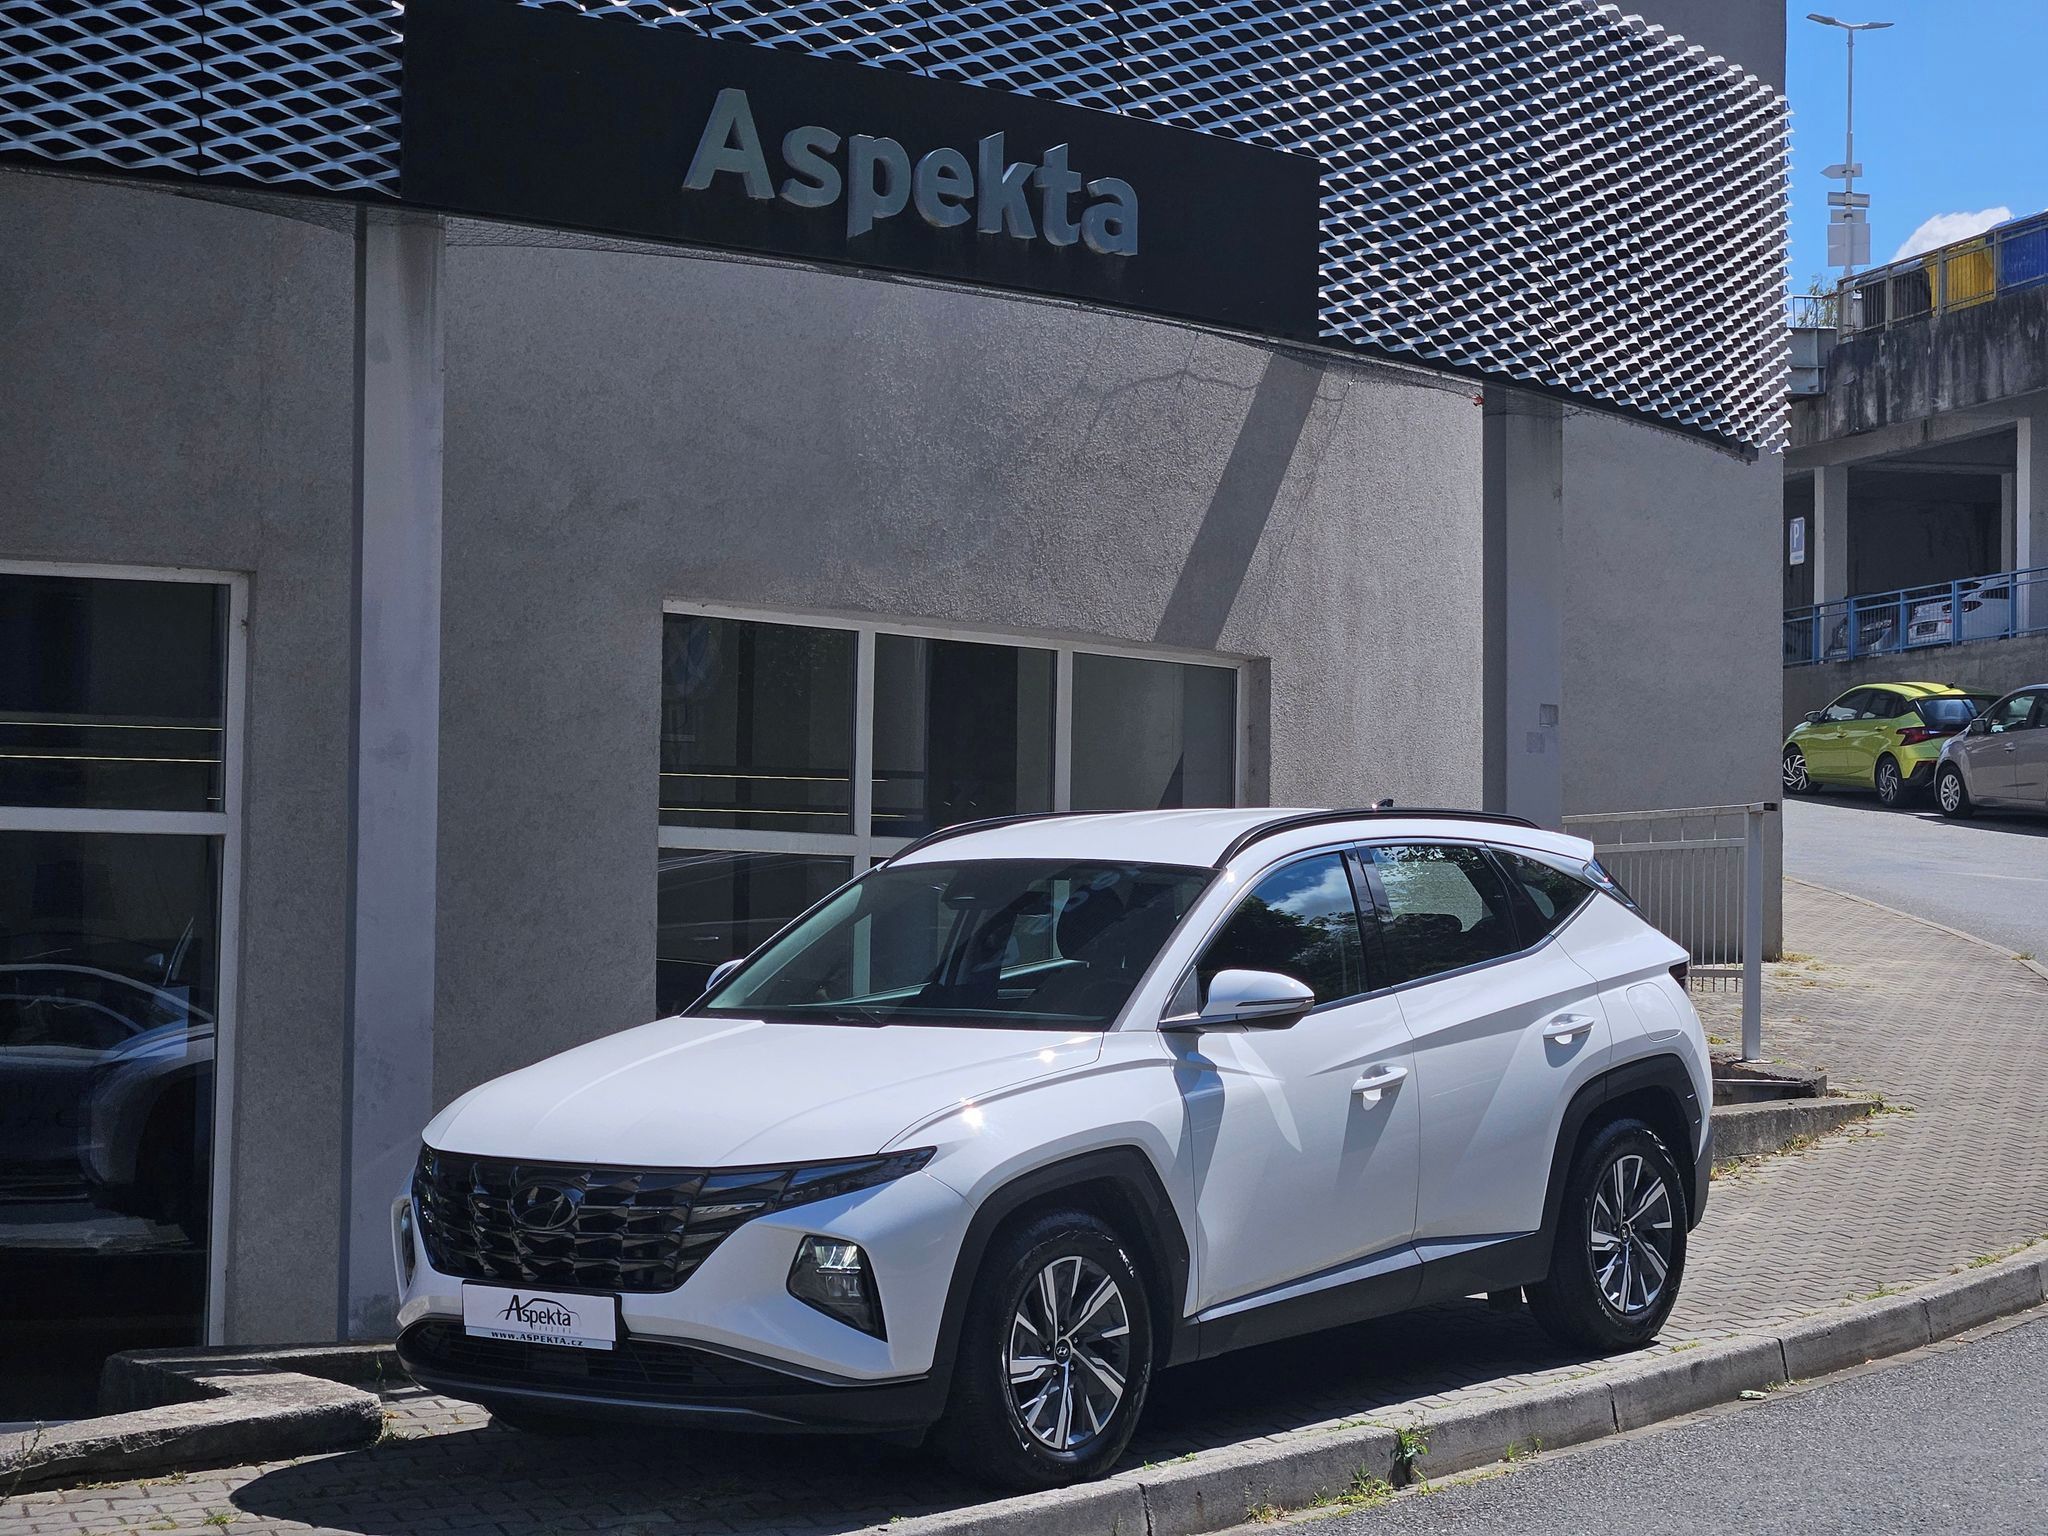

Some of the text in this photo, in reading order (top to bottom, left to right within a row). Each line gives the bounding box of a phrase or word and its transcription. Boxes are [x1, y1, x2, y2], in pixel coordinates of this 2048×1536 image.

[682, 87, 1139, 256] Aspekta
[1793, 523, 1800, 548] P
[505, 1294, 571, 1329] Aspekta
